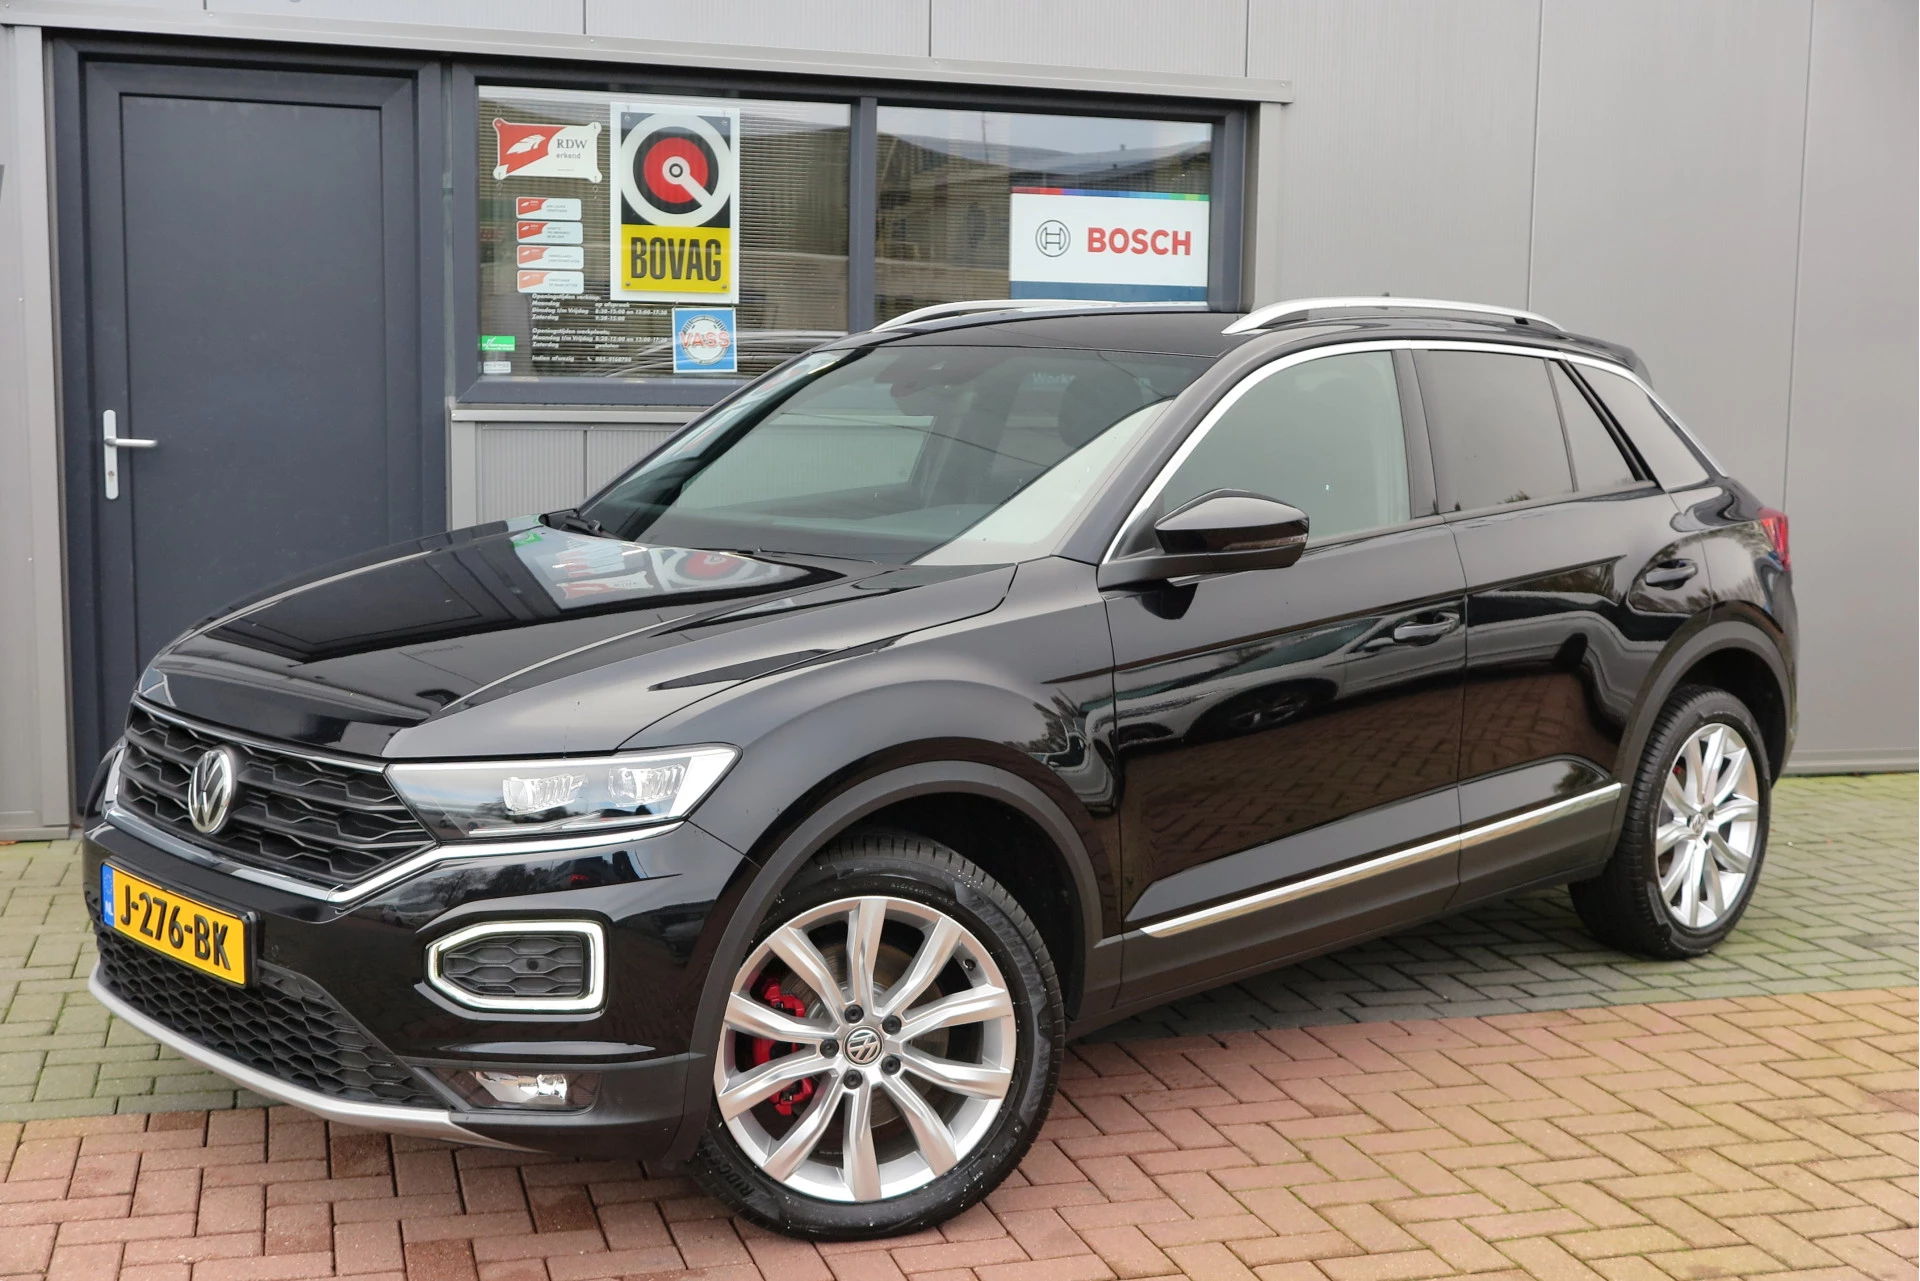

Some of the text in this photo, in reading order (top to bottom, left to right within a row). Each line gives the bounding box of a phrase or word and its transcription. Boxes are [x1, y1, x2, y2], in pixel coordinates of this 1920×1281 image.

[556, 138, 588, 150] RDW
[556, 151, 581, 160] erkend
[1087, 227, 1191, 256] BOSCH
[630, 235, 722, 282] BOVAG
[532, 334, 560, 342] Maandag
[679, 331, 731, 348] VASS
[105, 900, 114, 916] NL
[120, 884, 231, 971] J-276-BK
